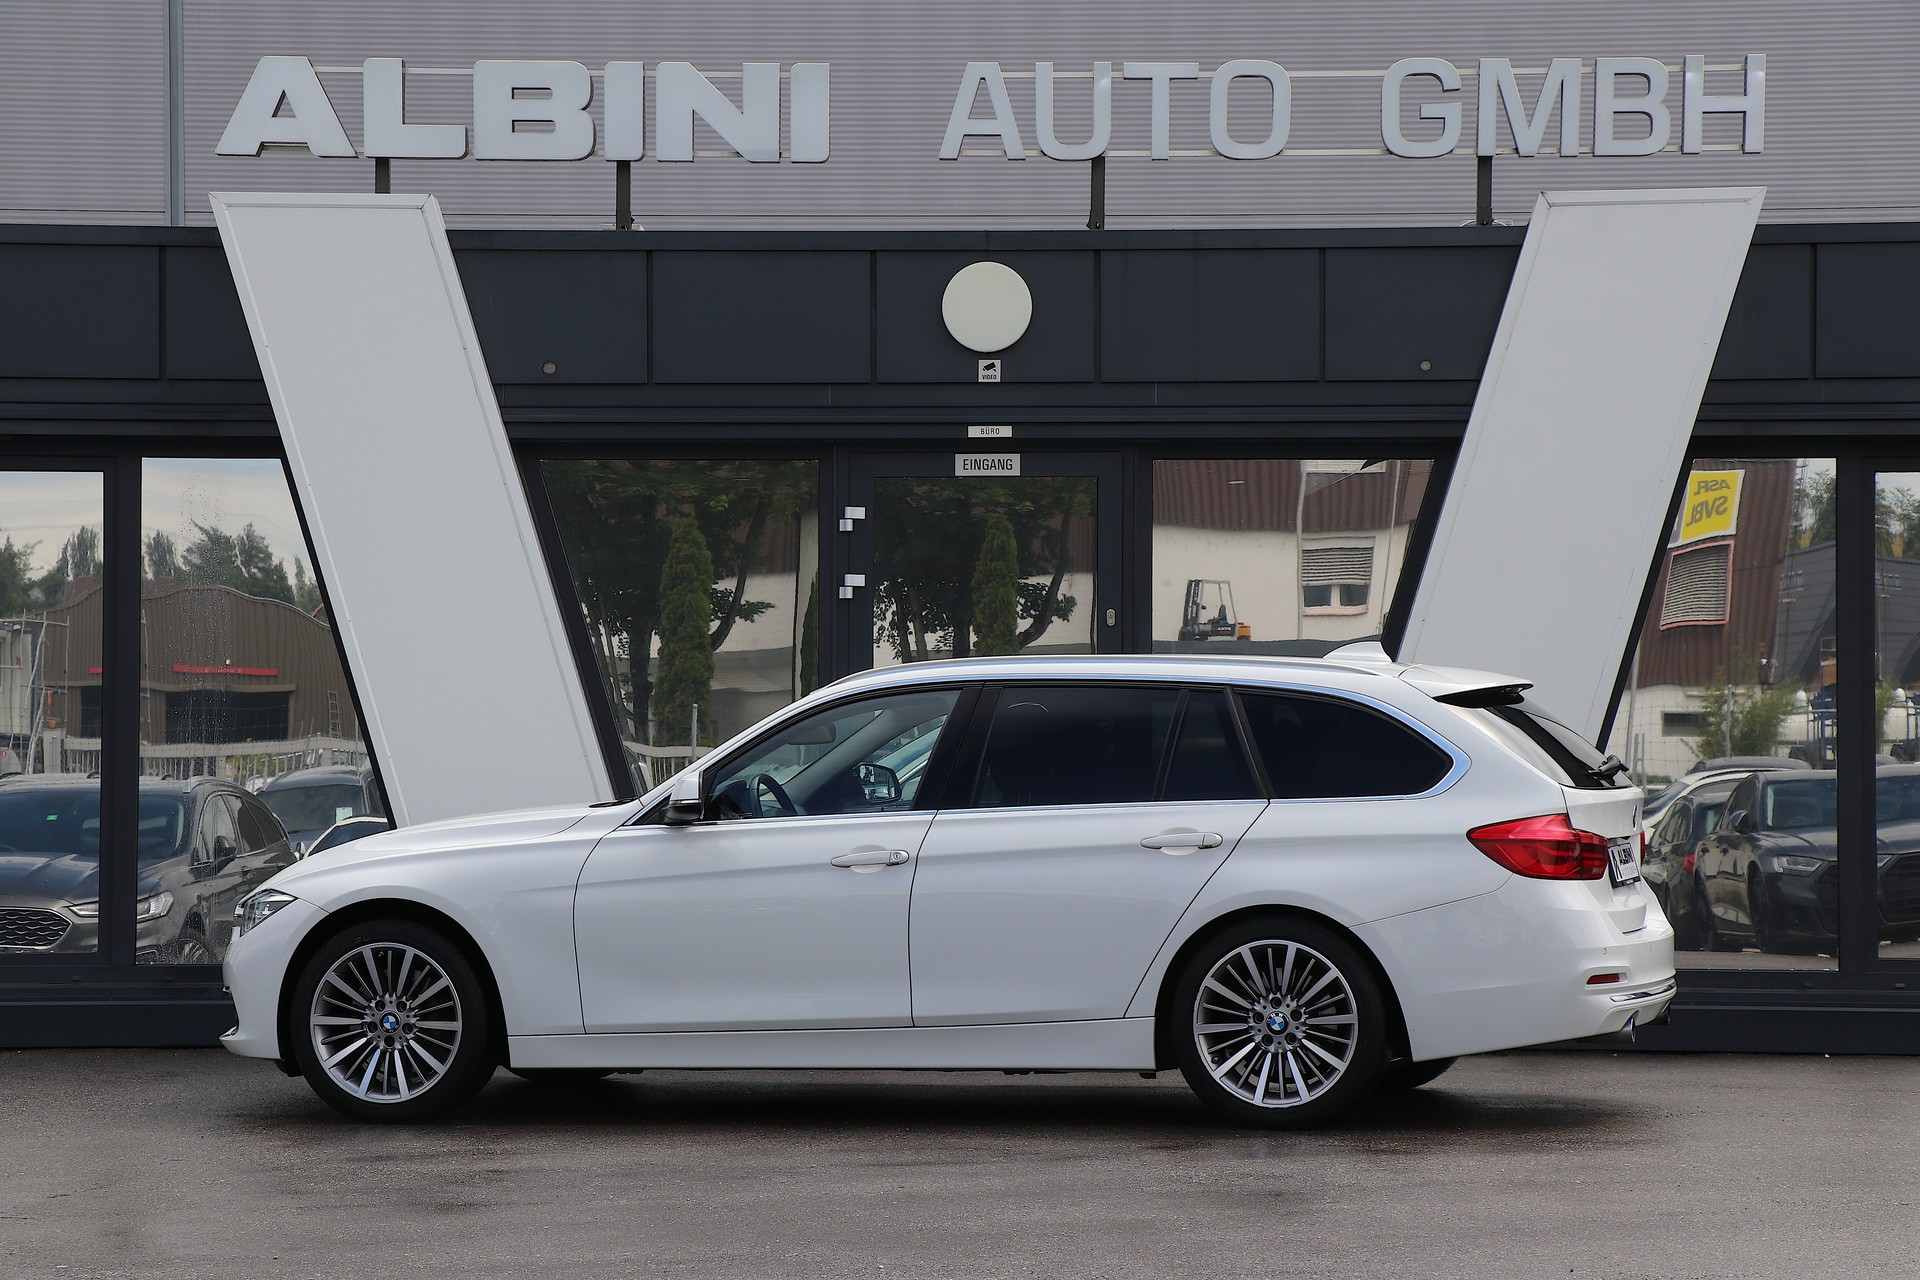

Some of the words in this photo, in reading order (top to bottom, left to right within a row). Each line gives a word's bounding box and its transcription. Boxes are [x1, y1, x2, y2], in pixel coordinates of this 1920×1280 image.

[214, 55, 831, 163] ALBINI
[938, 59, 1292, 161] AUTO
[1379, 53, 1767, 159] GMBH
[980, 427, 1000, 435] BÜRO
[963, 458, 1013, 471] EINGANG
